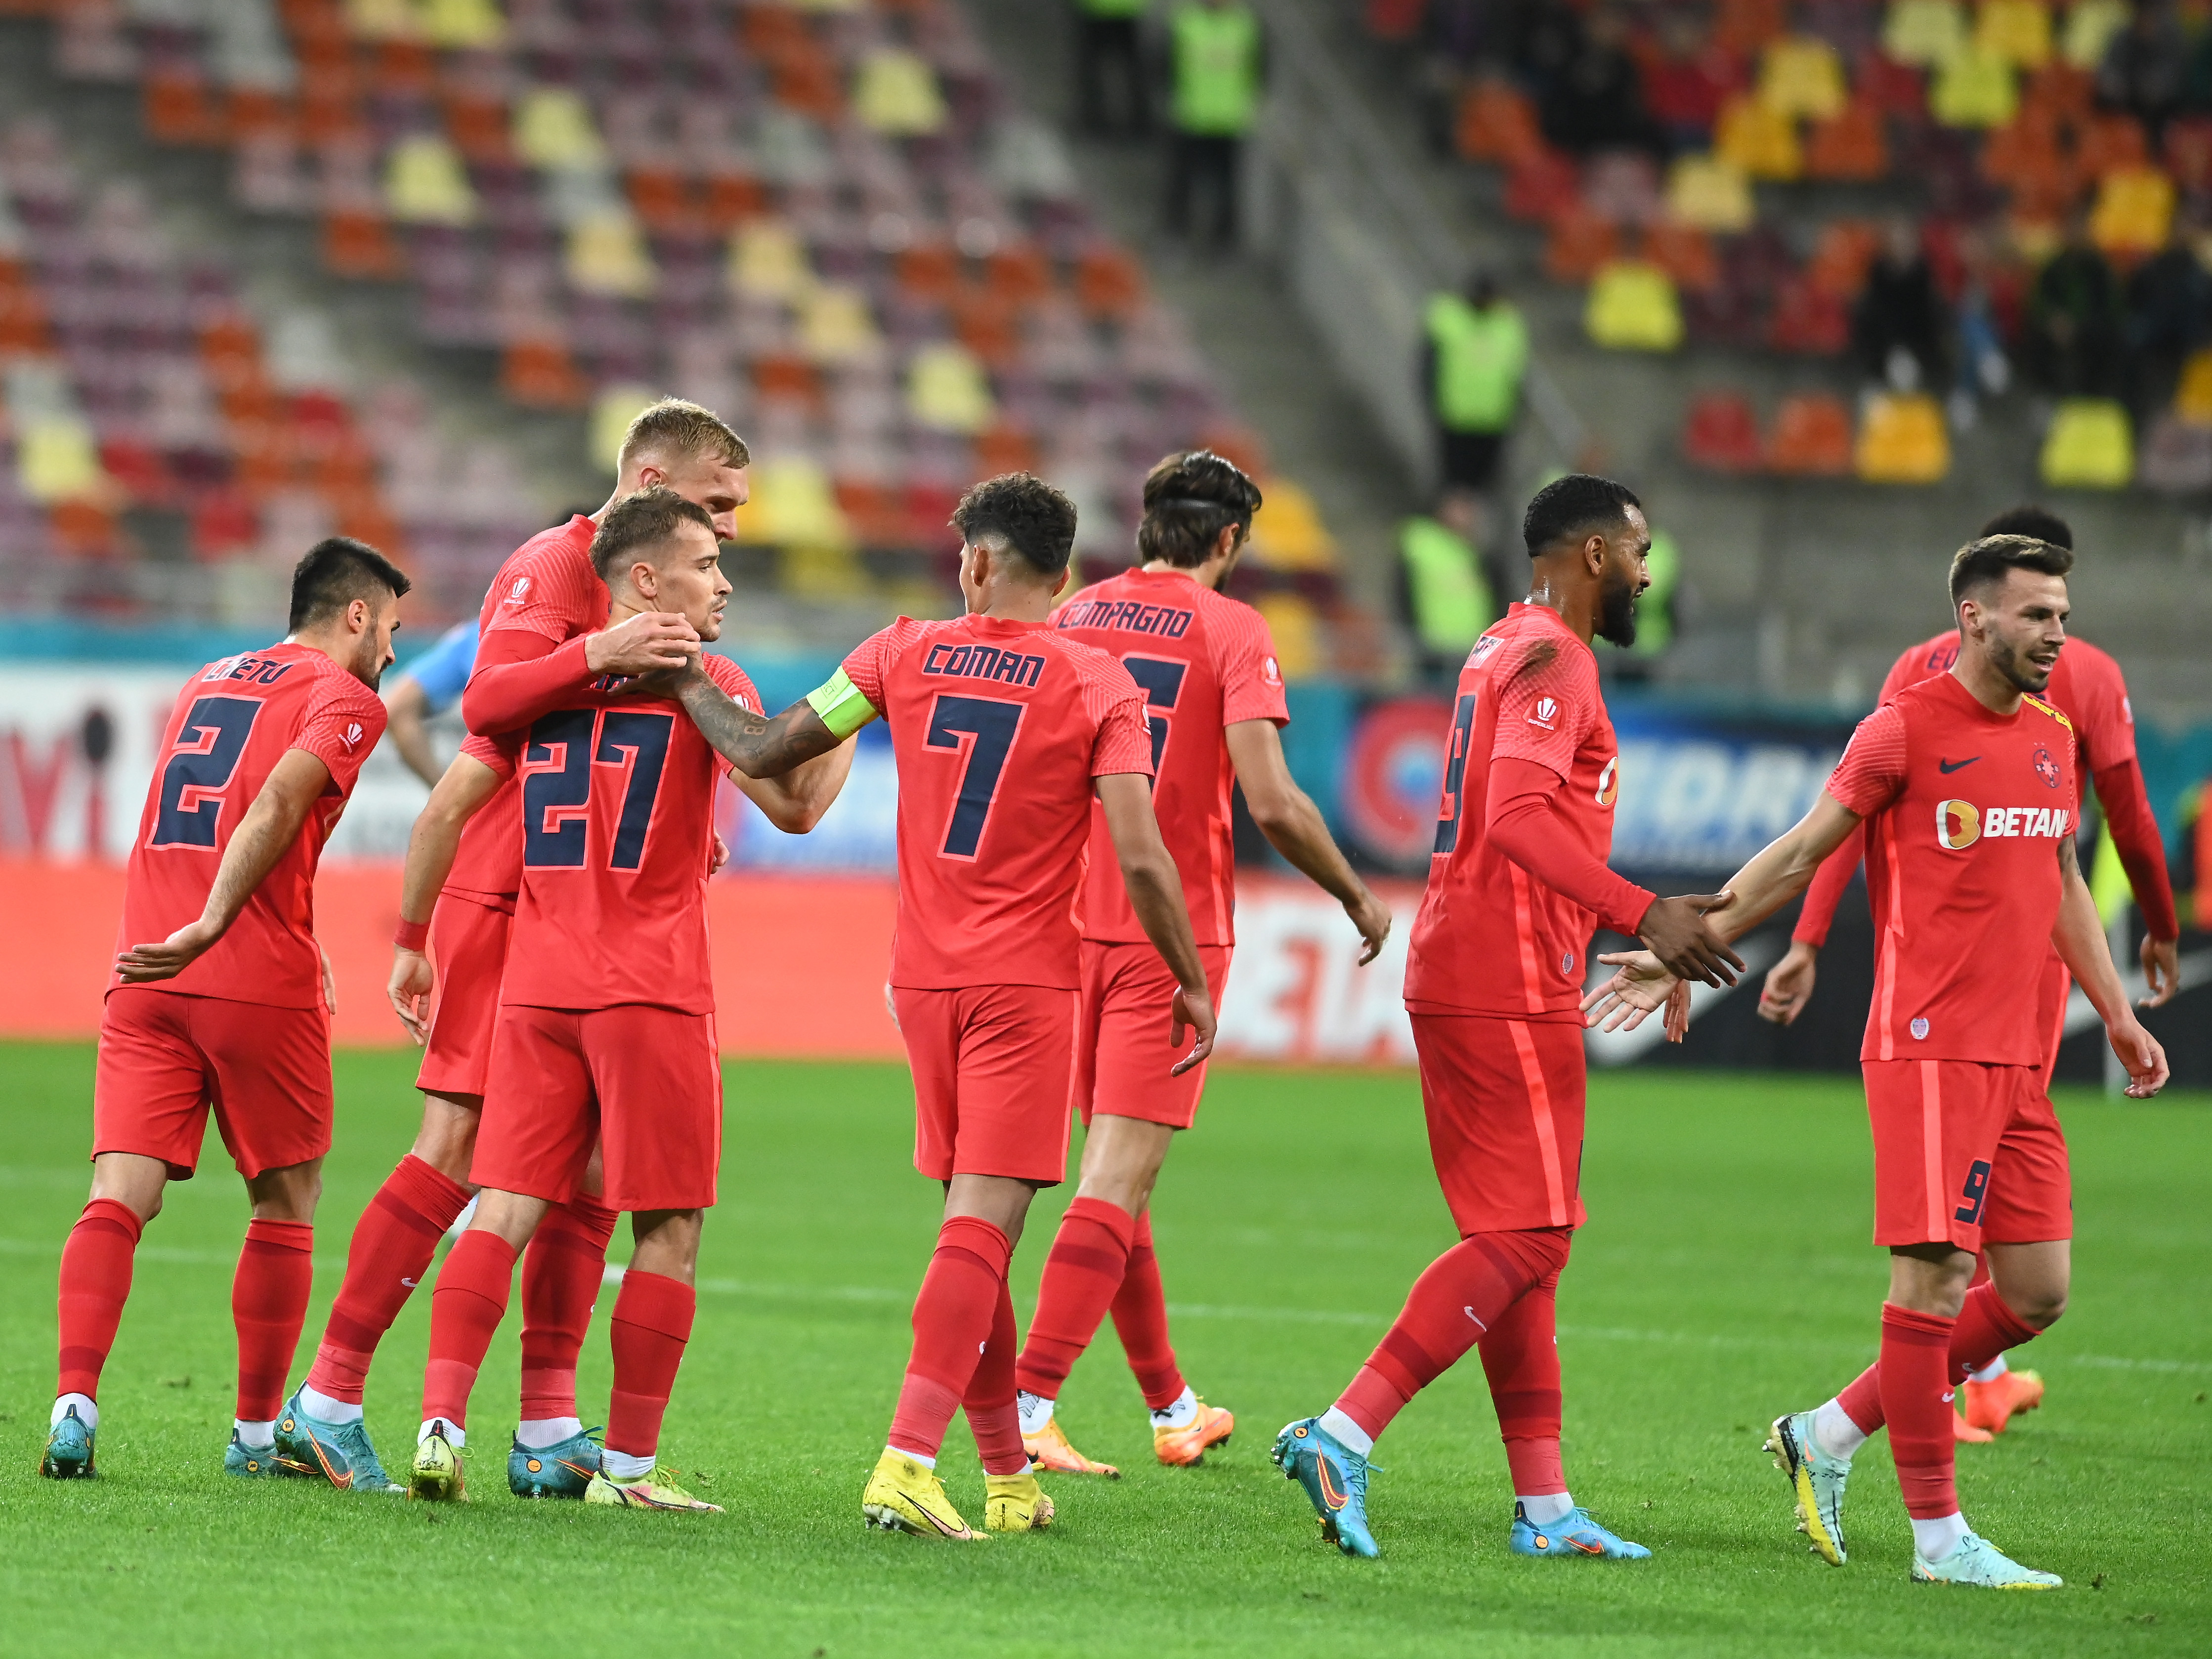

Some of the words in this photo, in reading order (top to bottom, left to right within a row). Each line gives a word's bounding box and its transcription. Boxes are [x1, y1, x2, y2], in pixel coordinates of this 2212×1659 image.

[1056, 600, 1195, 639] COMPAGNO
[922, 643, 1047, 689] COMAN
[145, 692, 267, 848] 2
[520, 707, 677, 874] 27
[922, 691, 1029, 863] 7
[1983, 807, 2070, 838] BETAN
[1954, 1159, 1992, 1228] 9
